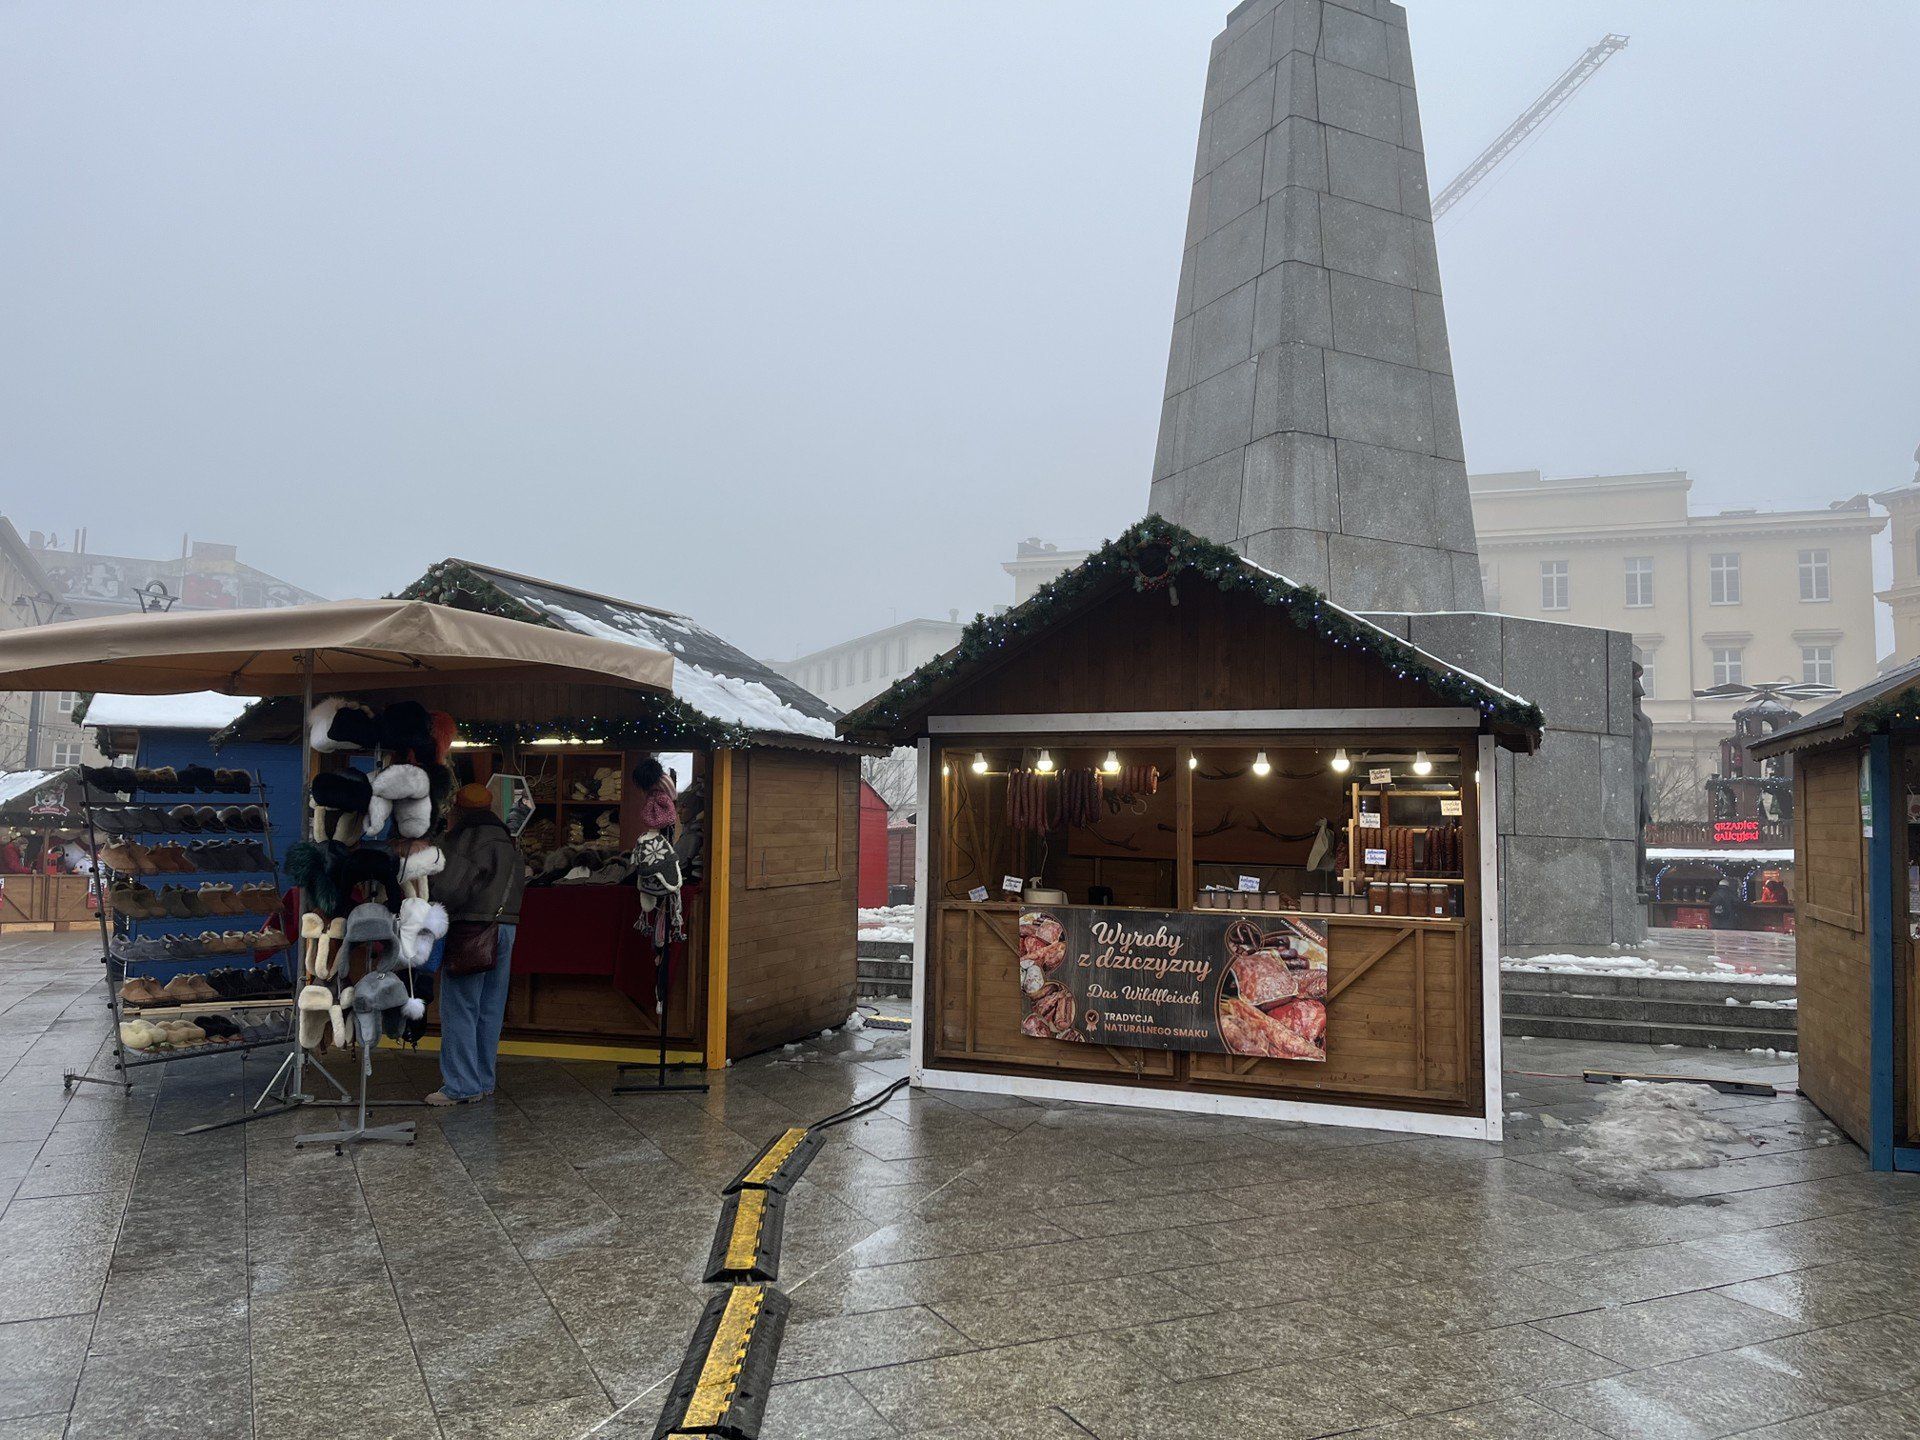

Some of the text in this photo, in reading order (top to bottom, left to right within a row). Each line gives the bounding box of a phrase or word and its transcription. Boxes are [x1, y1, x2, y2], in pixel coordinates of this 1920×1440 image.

[1091, 922, 1184, 957] Wyroby
[1077, 947, 1213, 982] z dziczyzny
[1086, 984, 1203, 1006] Das Wildfleisch
[1104, 1012, 1154, 1024] TRADYCJA
[1104, 1024, 1209, 1038] NATURALNEGO SMAKU
